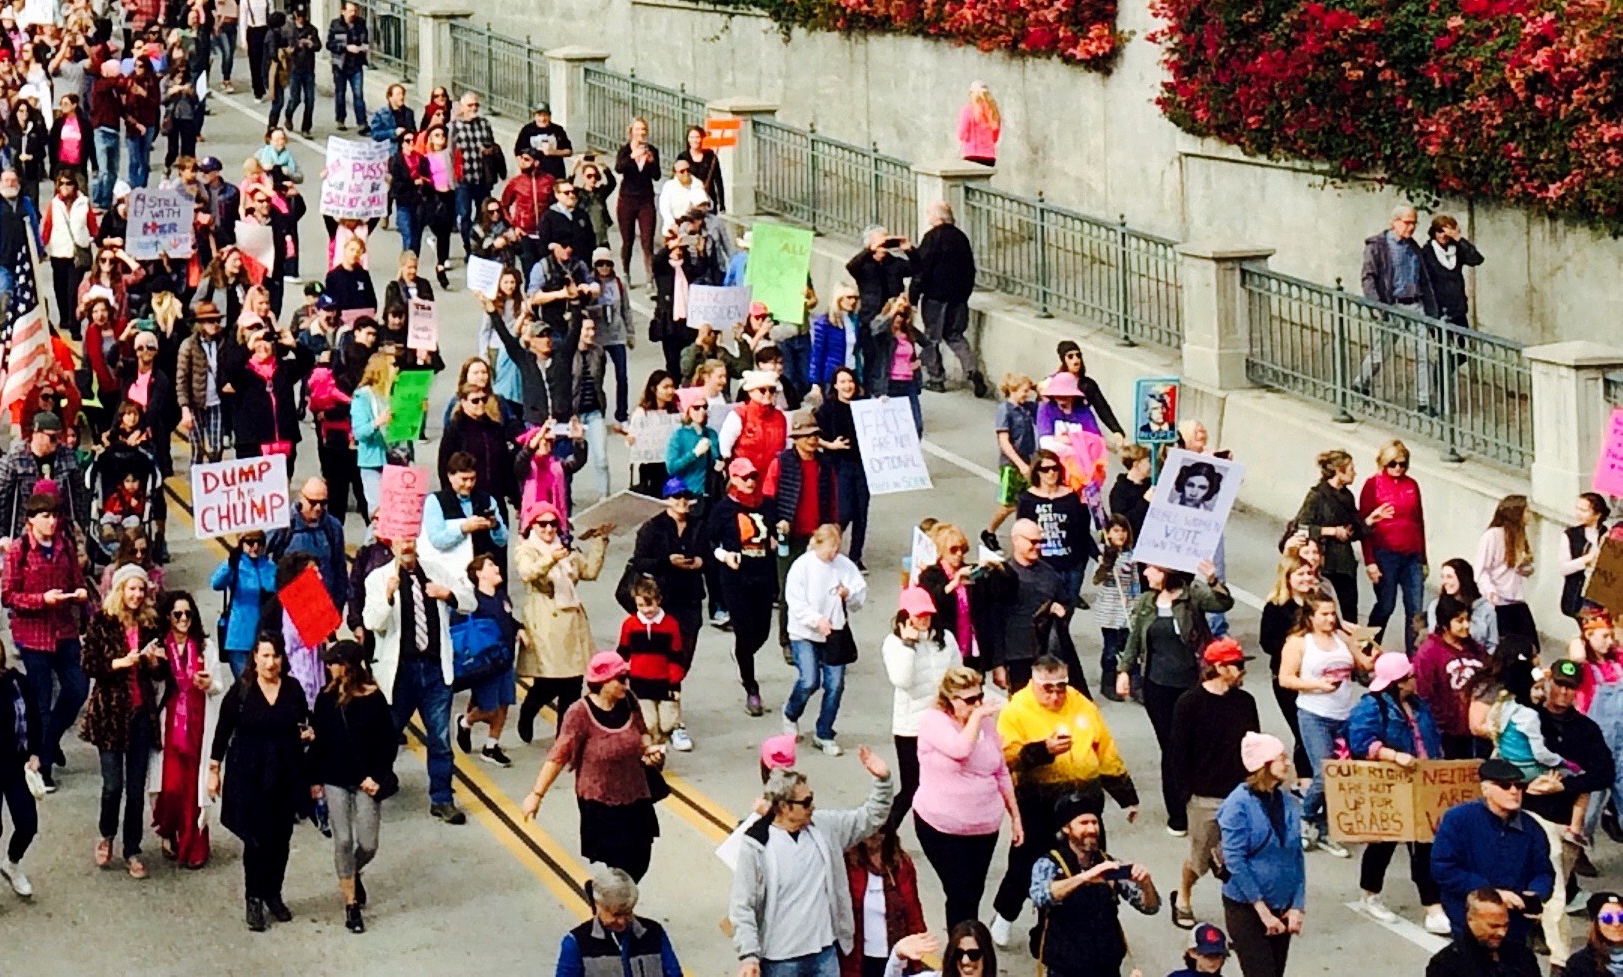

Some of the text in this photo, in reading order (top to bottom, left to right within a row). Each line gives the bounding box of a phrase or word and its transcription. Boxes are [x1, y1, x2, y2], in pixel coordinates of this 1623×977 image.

[150, 208, 181, 219] WITH
[201, 461, 271, 494] DUMP
[201, 493, 285, 533] CHUMP
[1165, 524, 1202, 543] VOTE
[1423, 768, 1481, 785] NEITHE
[1345, 797, 1394, 811] UP FOR
[1438, 789, 1474, 807] ARE
[1337, 812, 1404, 835] GRABS
